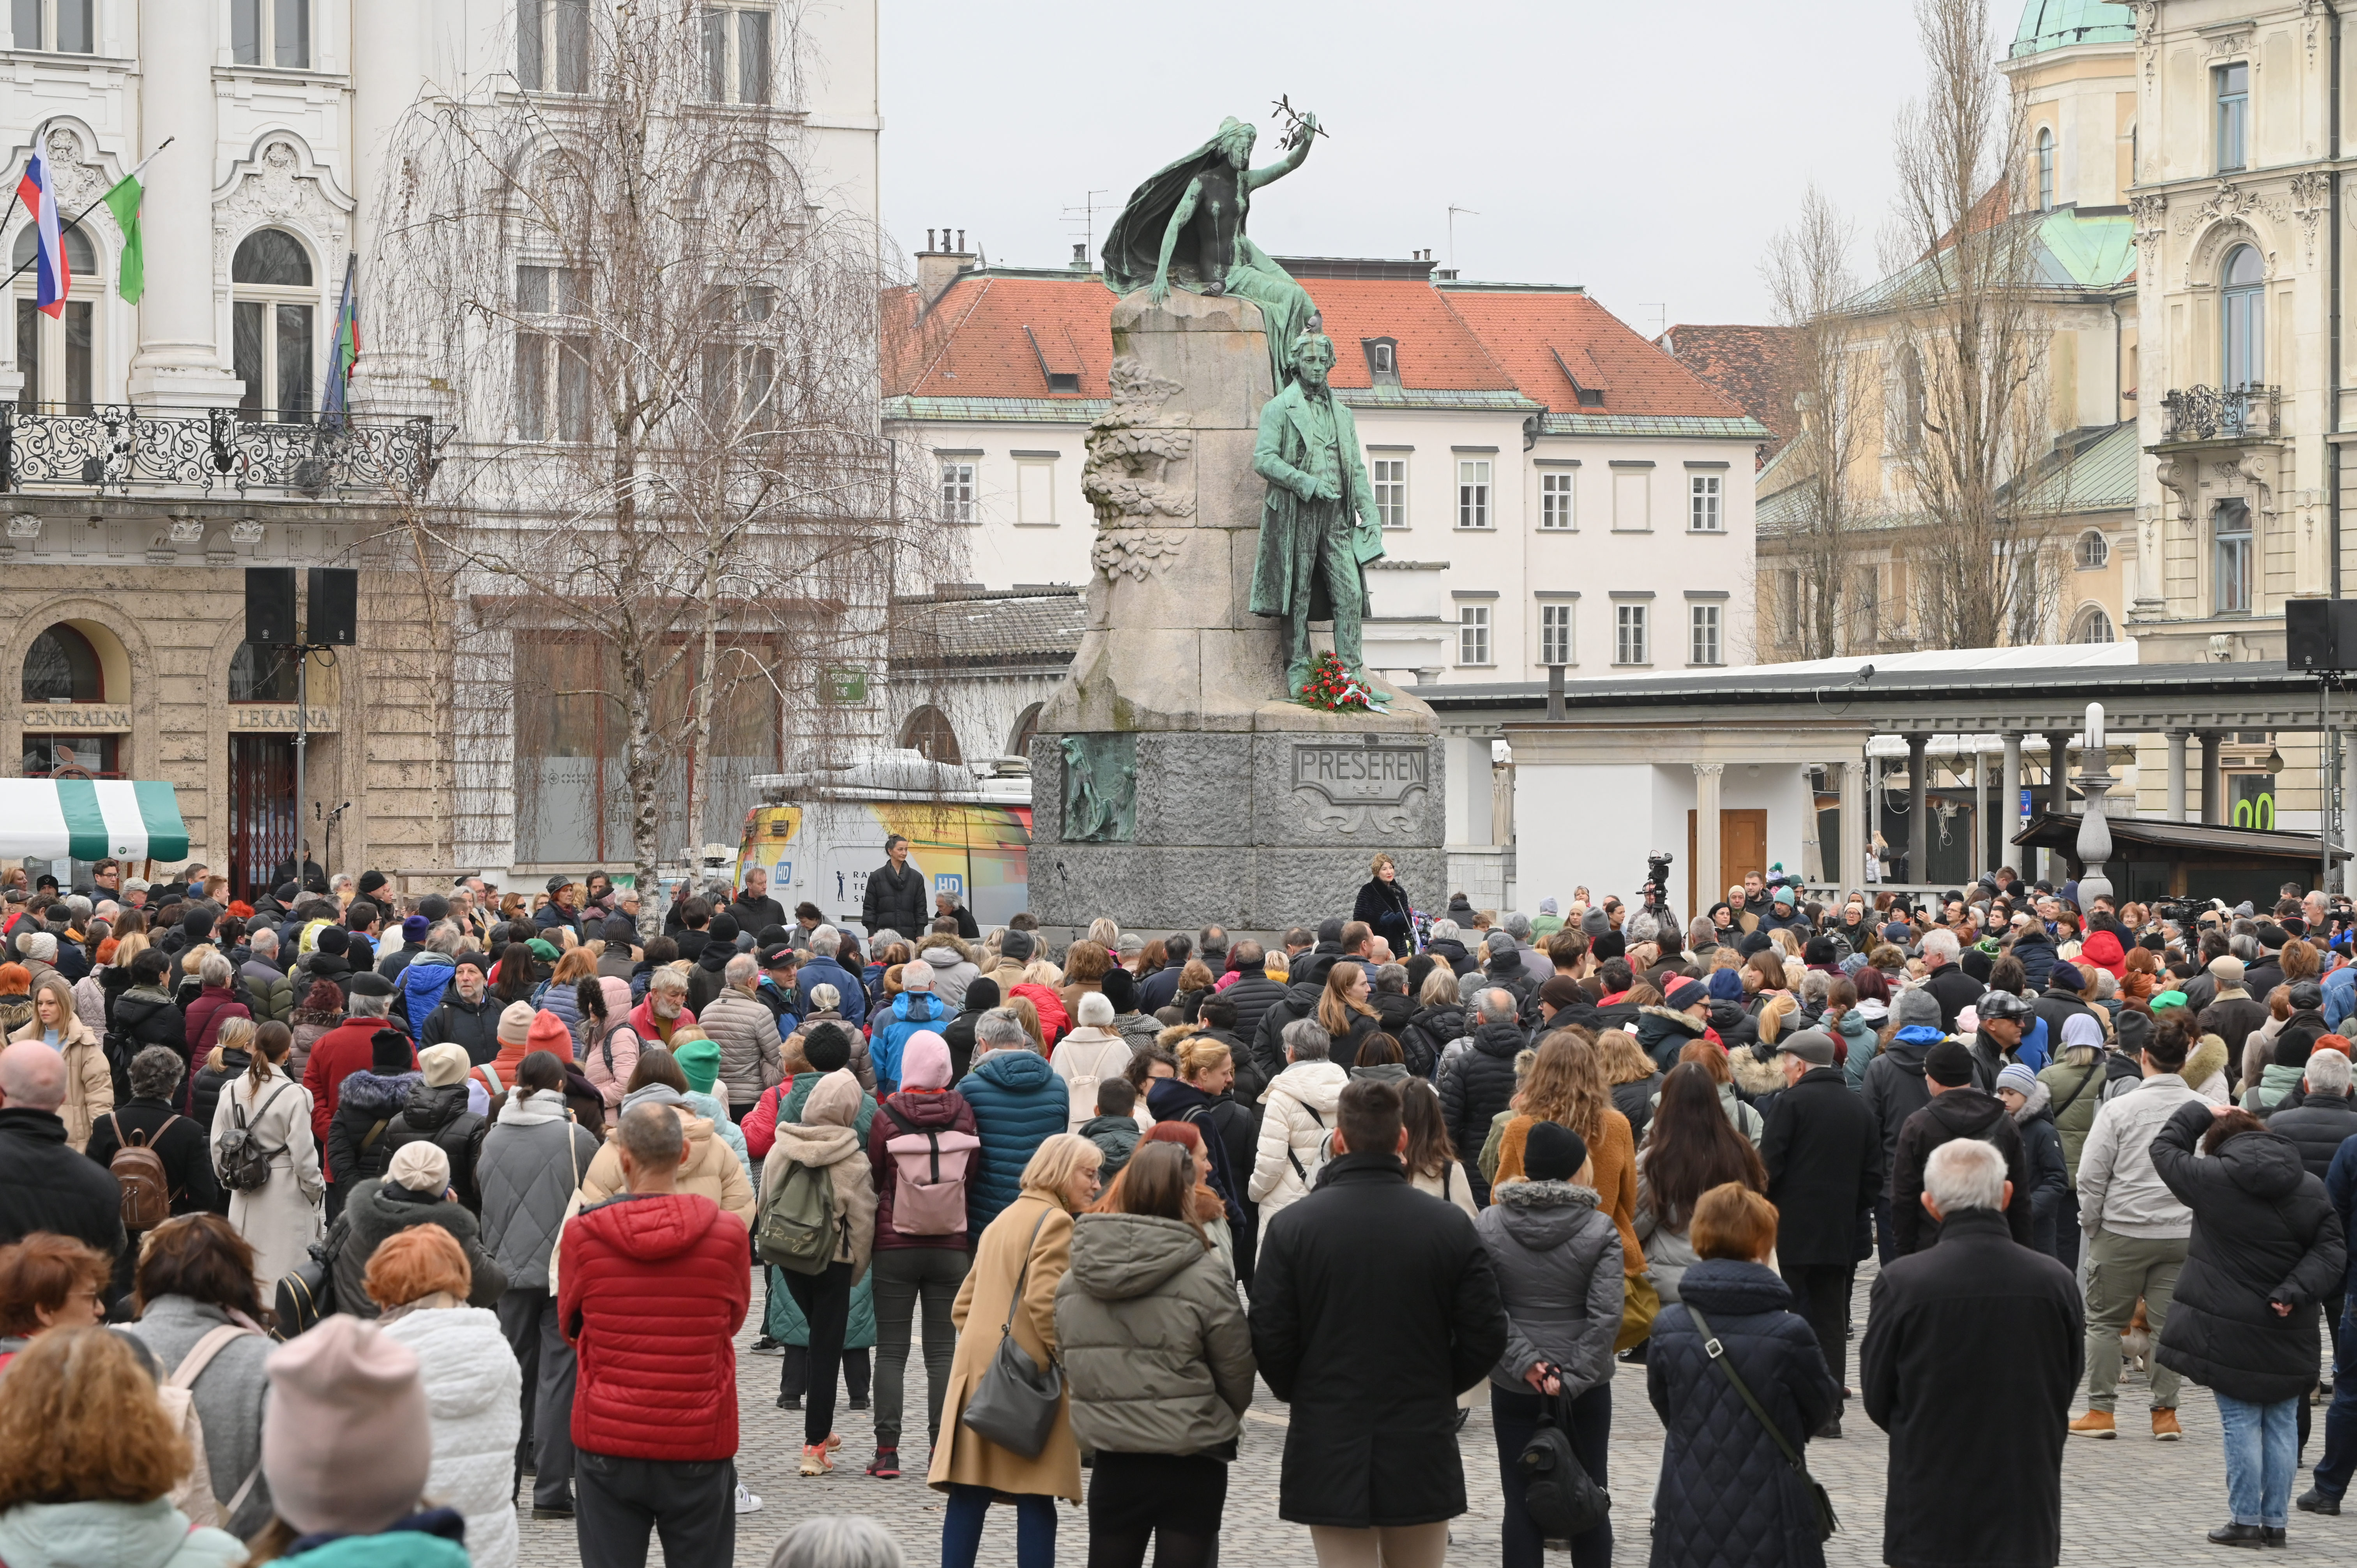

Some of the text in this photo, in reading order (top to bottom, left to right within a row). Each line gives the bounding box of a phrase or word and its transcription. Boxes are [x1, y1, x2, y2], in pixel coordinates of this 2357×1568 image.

[23, 710, 330, 727] CENTRALNA LEKARNA
[1301, 751, 1422, 780] PREŠEREN
[777, 865, 789, 880] HD
[938, 878, 959, 893] HD
